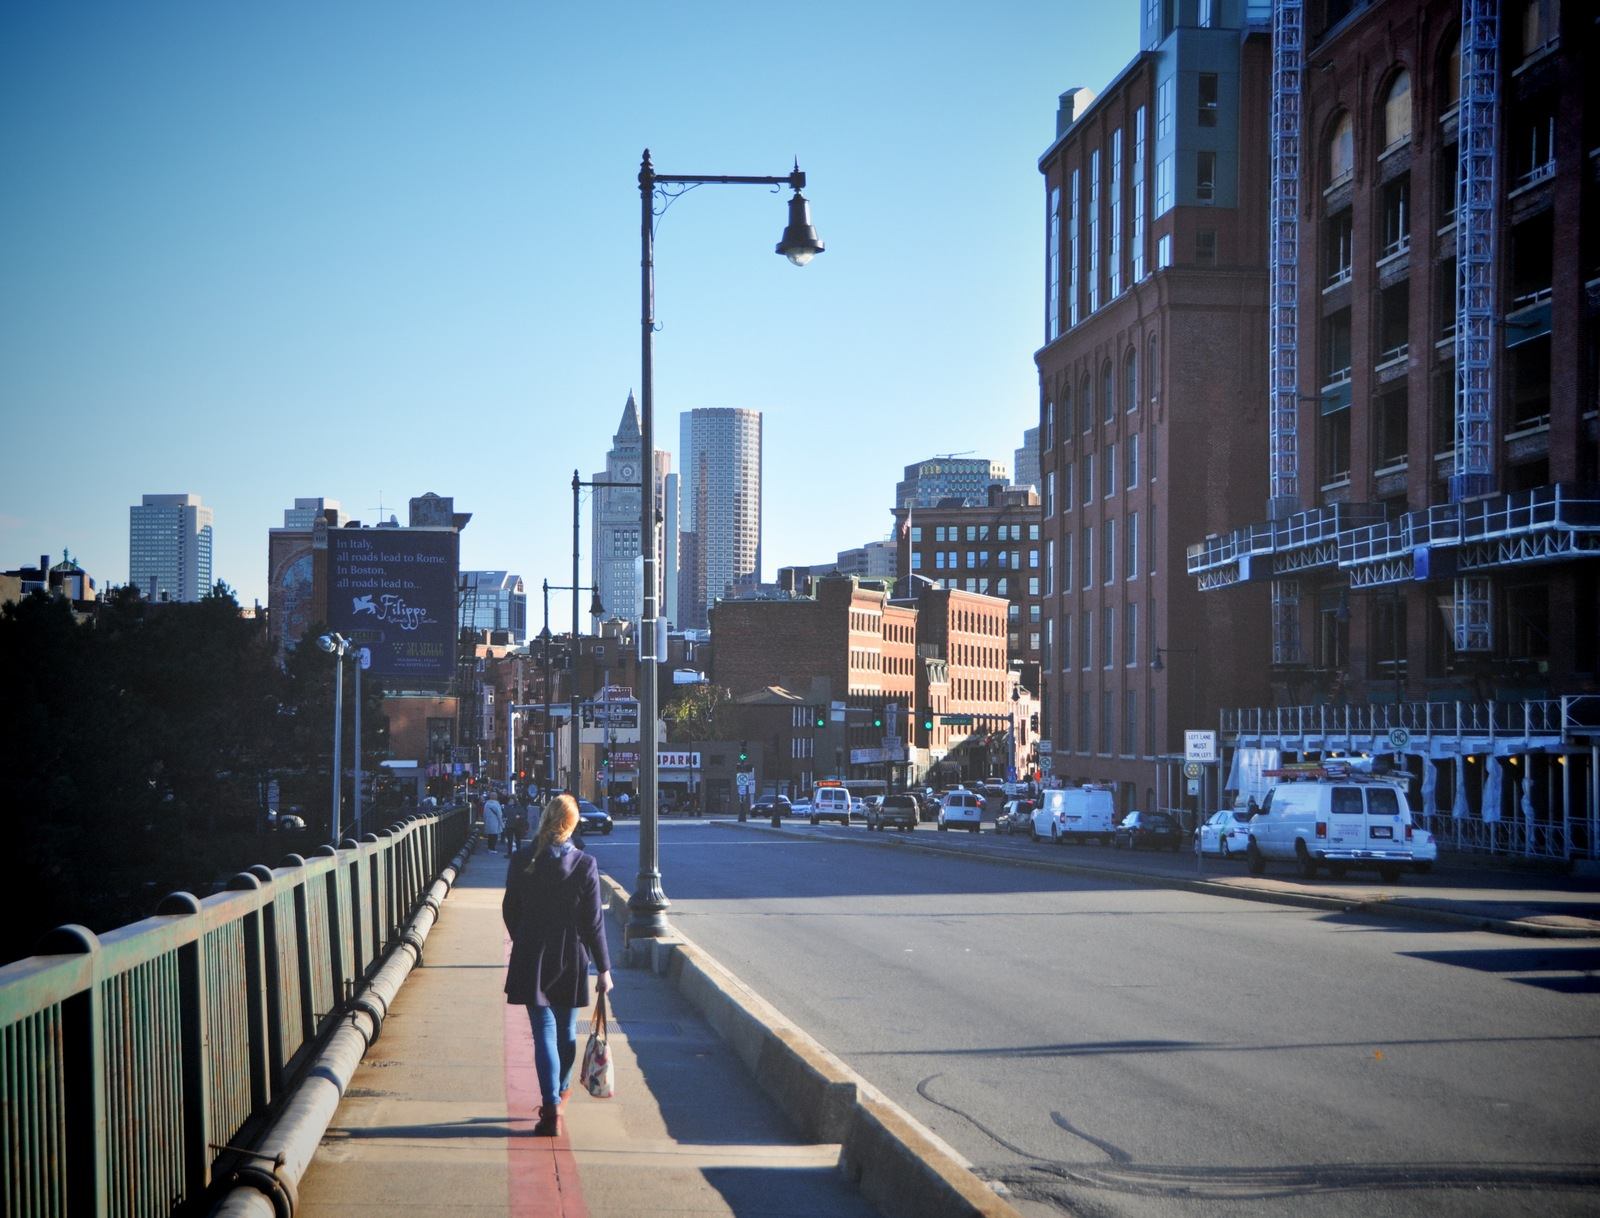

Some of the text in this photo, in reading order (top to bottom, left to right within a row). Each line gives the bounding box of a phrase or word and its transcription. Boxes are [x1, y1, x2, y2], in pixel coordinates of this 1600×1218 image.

[337, 539, 373, 551] In Italy,
[336, 551, 448, 564] all roads lead to Rome.
[337, 565, 348, 575] In
[336, 578, 349, 588] all
[351, 578, 378, 588] roads
[380, 579, 401, 589] lead
[377, 594, 427, 630] Filippo
